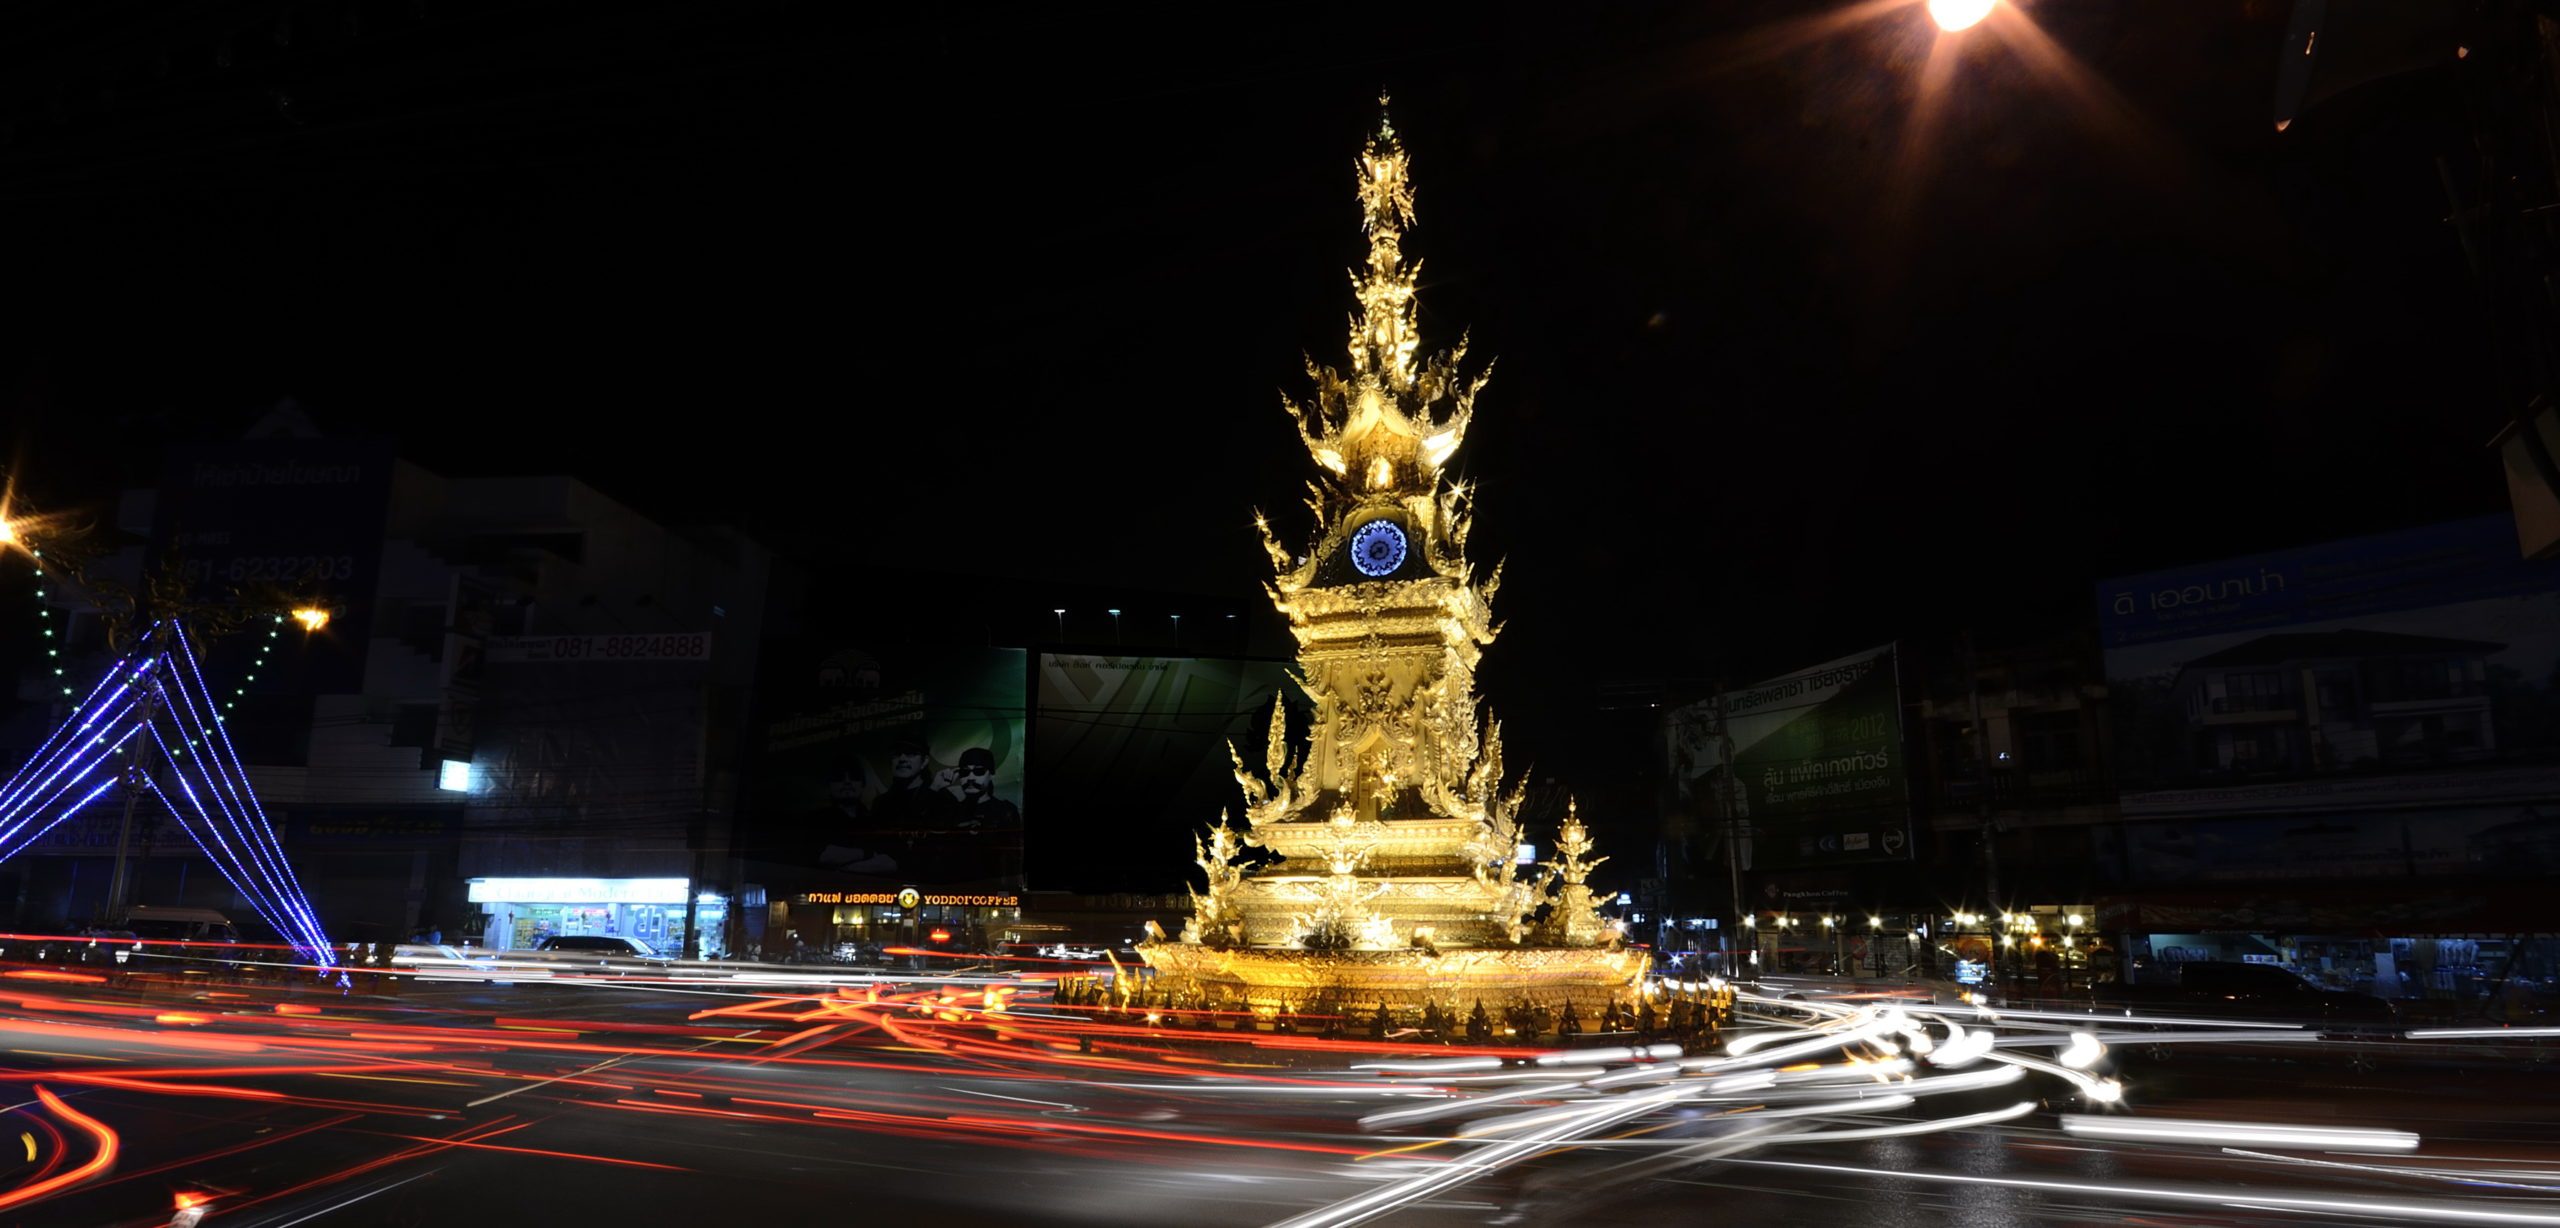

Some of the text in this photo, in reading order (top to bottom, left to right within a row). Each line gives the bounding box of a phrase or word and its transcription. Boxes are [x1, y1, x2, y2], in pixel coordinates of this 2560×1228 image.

[181, 554, 353, 583] 81-6232203
[555, 636, 704, 658] 081-8824888
[1851, 713, 1887, 741] 2012
[808, 892, 842, 904] กาแฟ
[972, 896, 1018, 906] COFFEE
